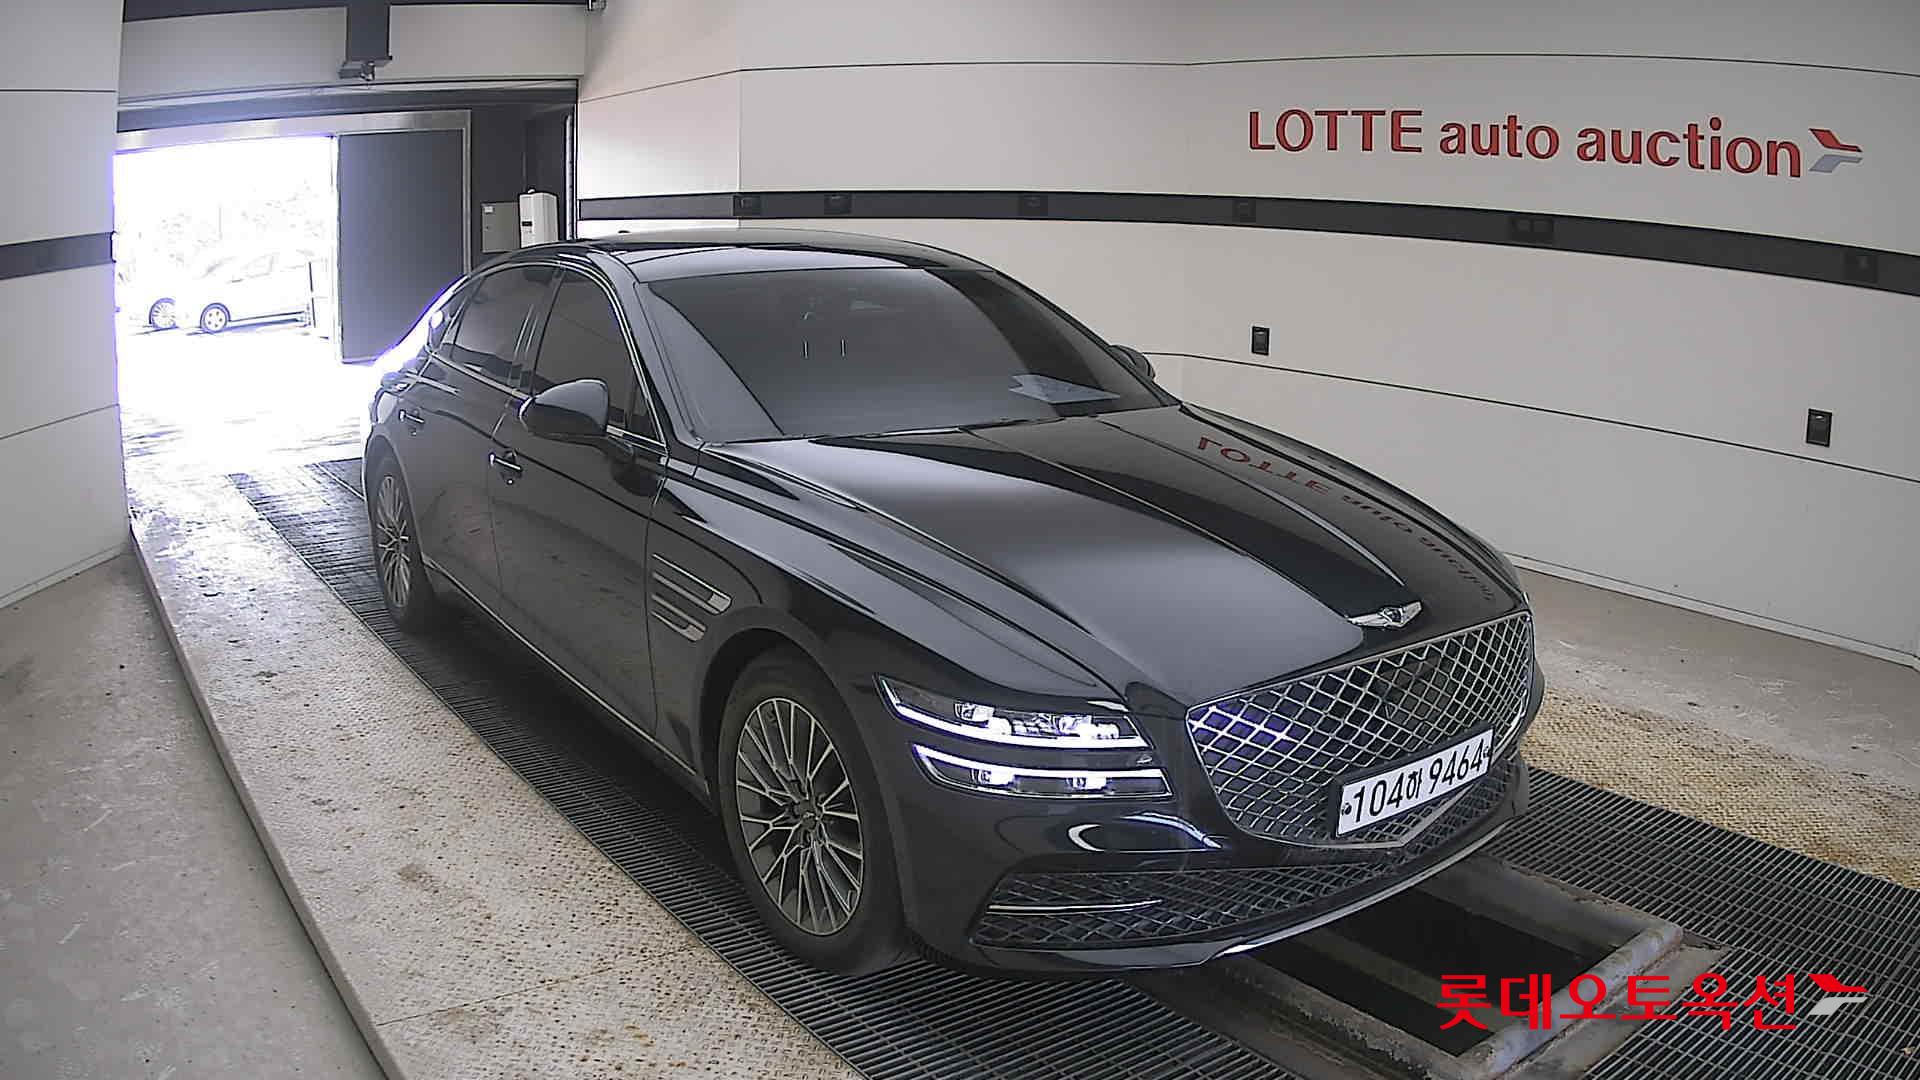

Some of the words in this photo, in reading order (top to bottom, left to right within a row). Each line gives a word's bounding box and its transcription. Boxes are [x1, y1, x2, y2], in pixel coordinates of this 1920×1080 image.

[1248, 109, 1422, 153] LOTTE
[1438, 114, 1560, 160] auto
[1575, 116, 1802, 178] auction
[1353, 766, 1423, 824] 104하
[1428, 737, 1485, 794] 9464
